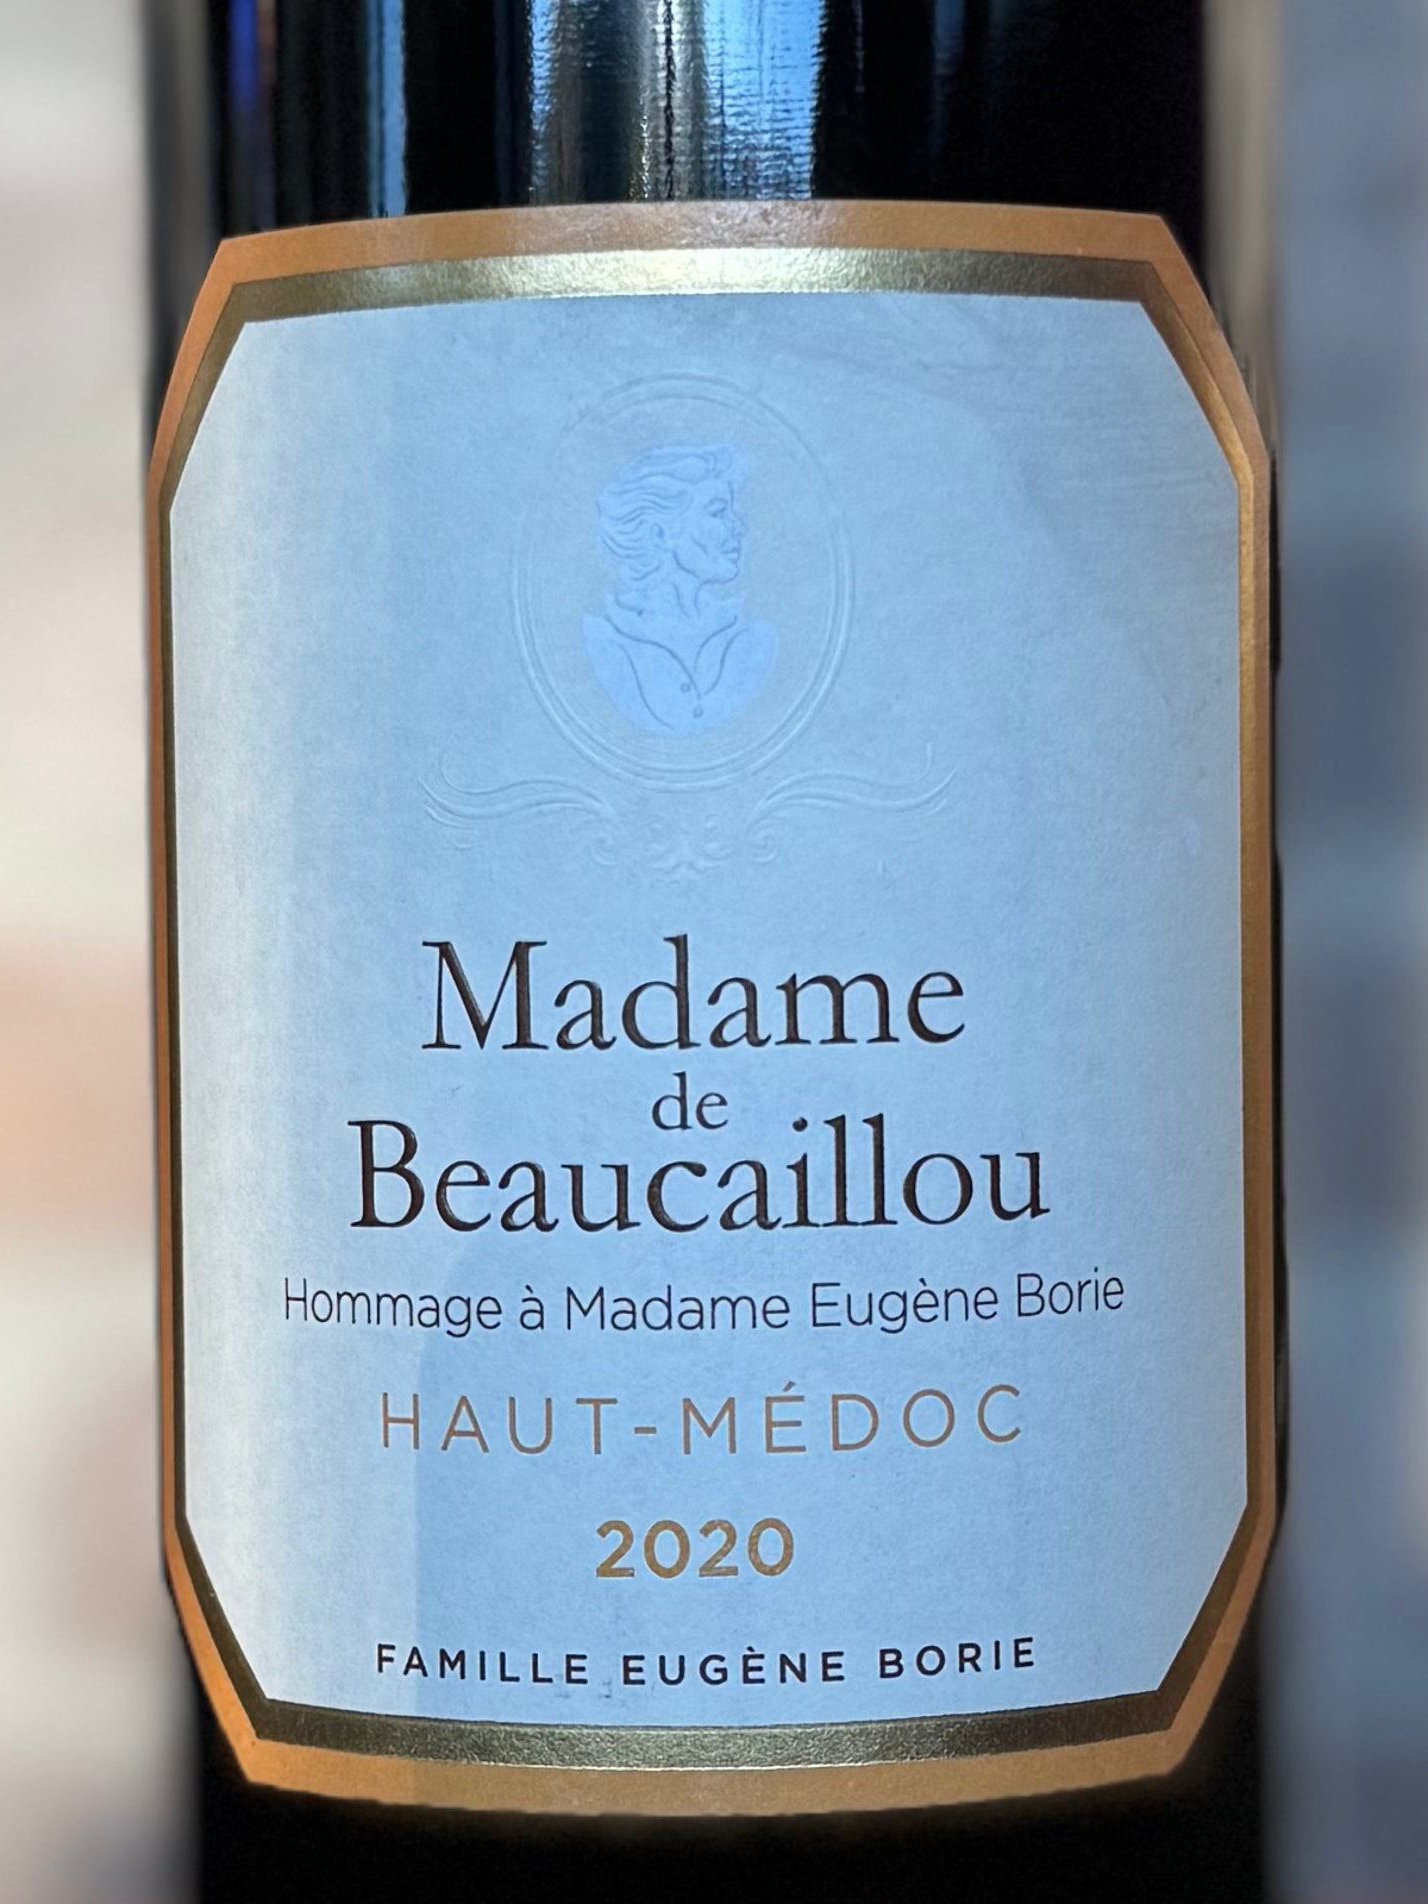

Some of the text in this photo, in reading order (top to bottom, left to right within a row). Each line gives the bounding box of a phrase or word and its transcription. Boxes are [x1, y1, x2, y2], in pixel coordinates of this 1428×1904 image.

[421, 933, 966, 1051] Madame
[651, 1071, 729, 1131] de
[346, 1112, 1051, 1234] Beaucaillou
[283, 1267, 1125, 1339] Hommage à Madame Eugène Borie
[382, 1380, 1024, 1456] HAUT-MÉDOC
[595, 1517, 795, 1580] 2020
[377, 1636, 1036, 1686] FAMILLE EUGÈNE BORIE
